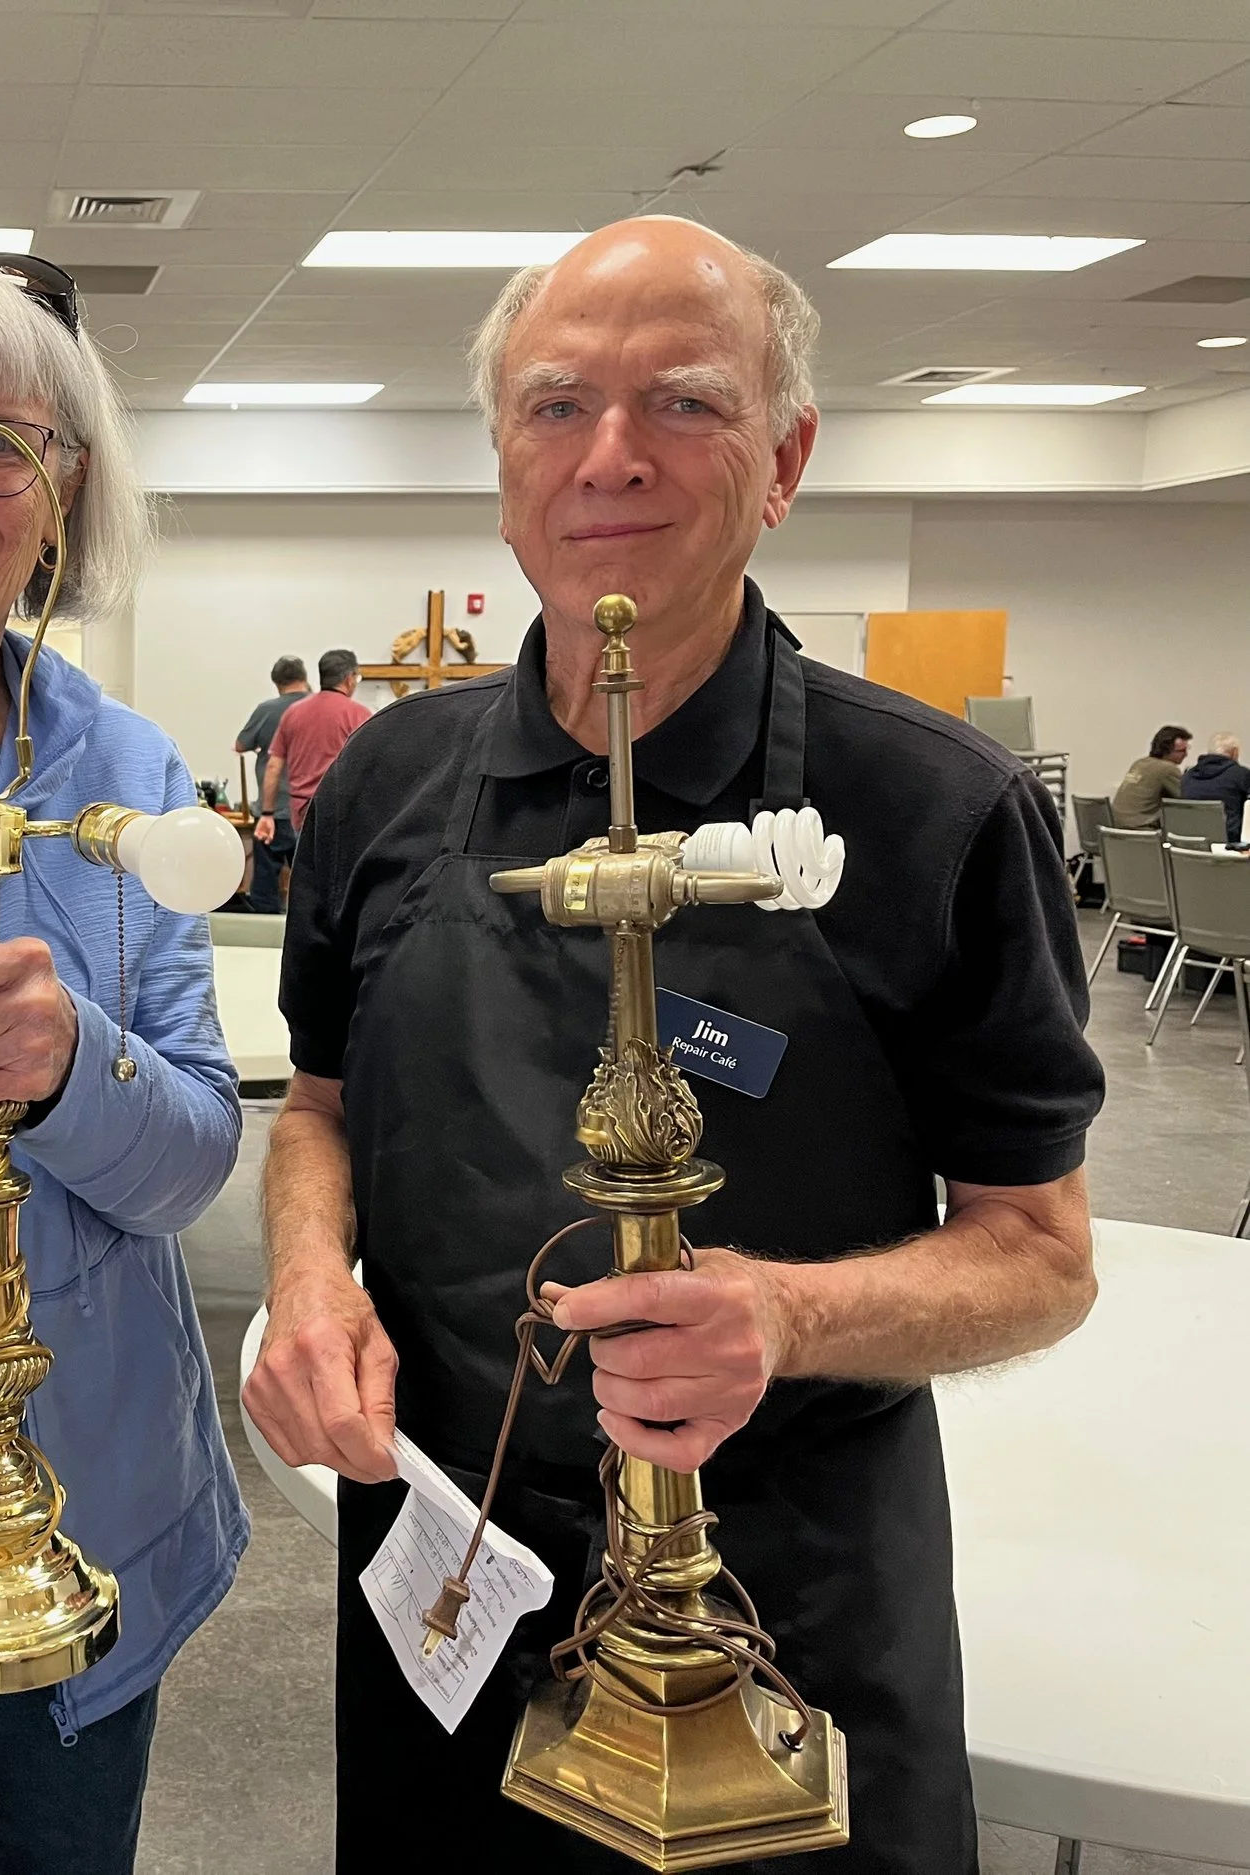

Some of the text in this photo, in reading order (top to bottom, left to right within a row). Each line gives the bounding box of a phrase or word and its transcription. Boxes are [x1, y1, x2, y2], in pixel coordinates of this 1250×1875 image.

[691, 1020, 729, 1047] Jim
[671, 1036, 738, 1070] Repair Café
